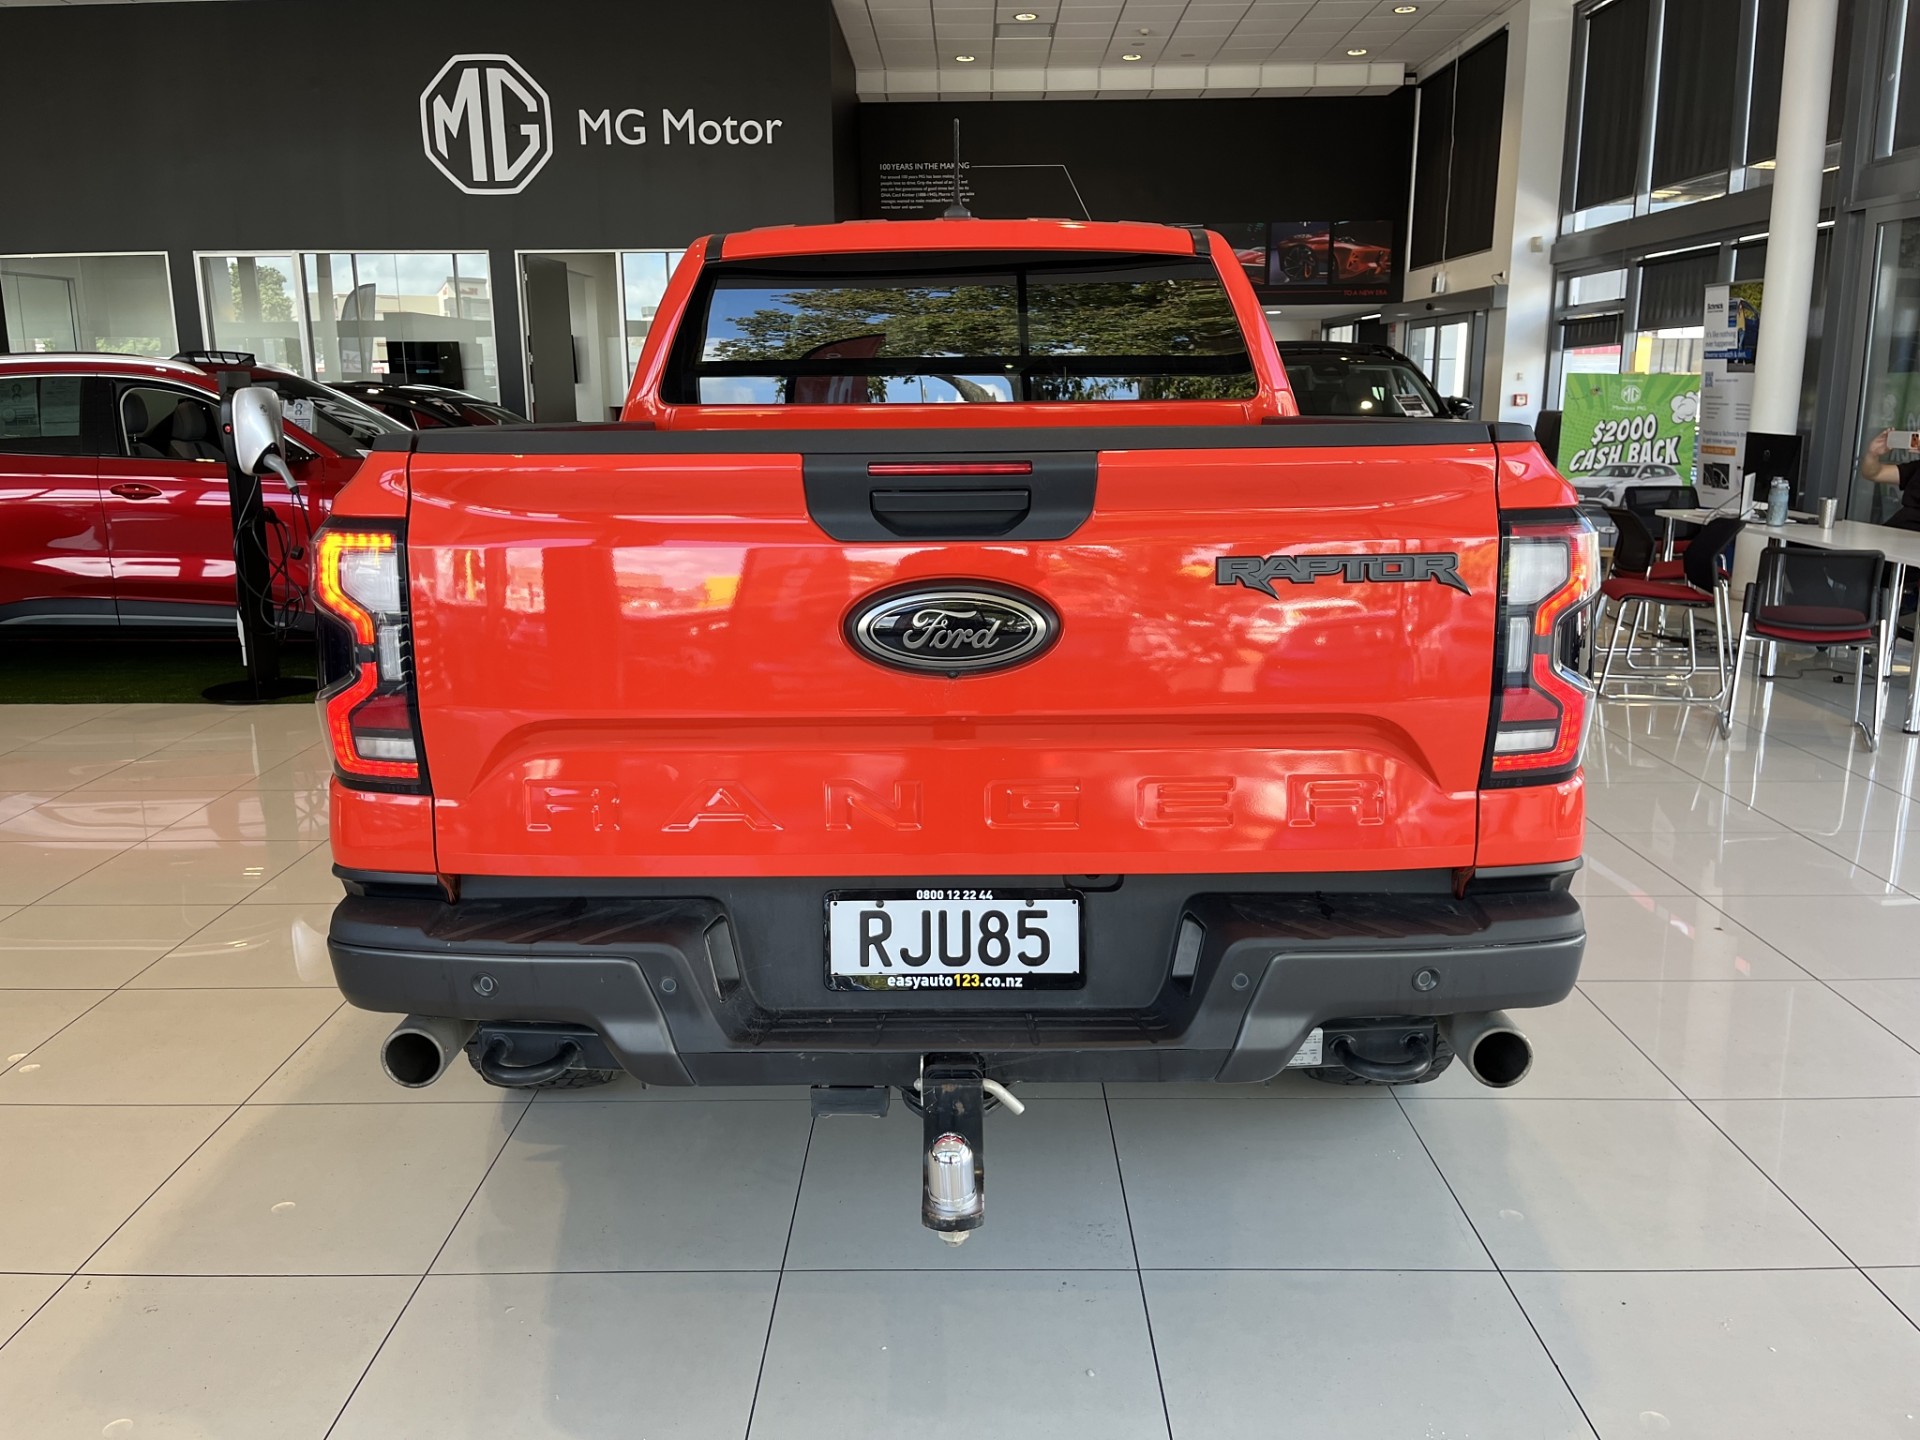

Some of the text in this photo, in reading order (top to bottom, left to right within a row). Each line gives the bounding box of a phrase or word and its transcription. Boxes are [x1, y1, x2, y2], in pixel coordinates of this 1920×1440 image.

[432, 67, 541, 182] MG
[578, 108, 783, 145] MG Motor
[890, 162, 914, 170] YEARS
[924, 162, 938, 170] THE
[940, 162, 970, 170] MAKNG
[1590, 413, 1657, 446] $2000
[1568, 436, 1680, 472] CASH BACK
[1216, 552, 1472, 600] RAPTOR
[903, 609, 1000, 650] Ford
[522, 773, 1386, 832] RANGER
[916, 890, 993, 900] 0800 12 22 44
[859, 909, 1051, 968] RJU85
[887, 974, 1023, 990] easyauto123.co.nz
